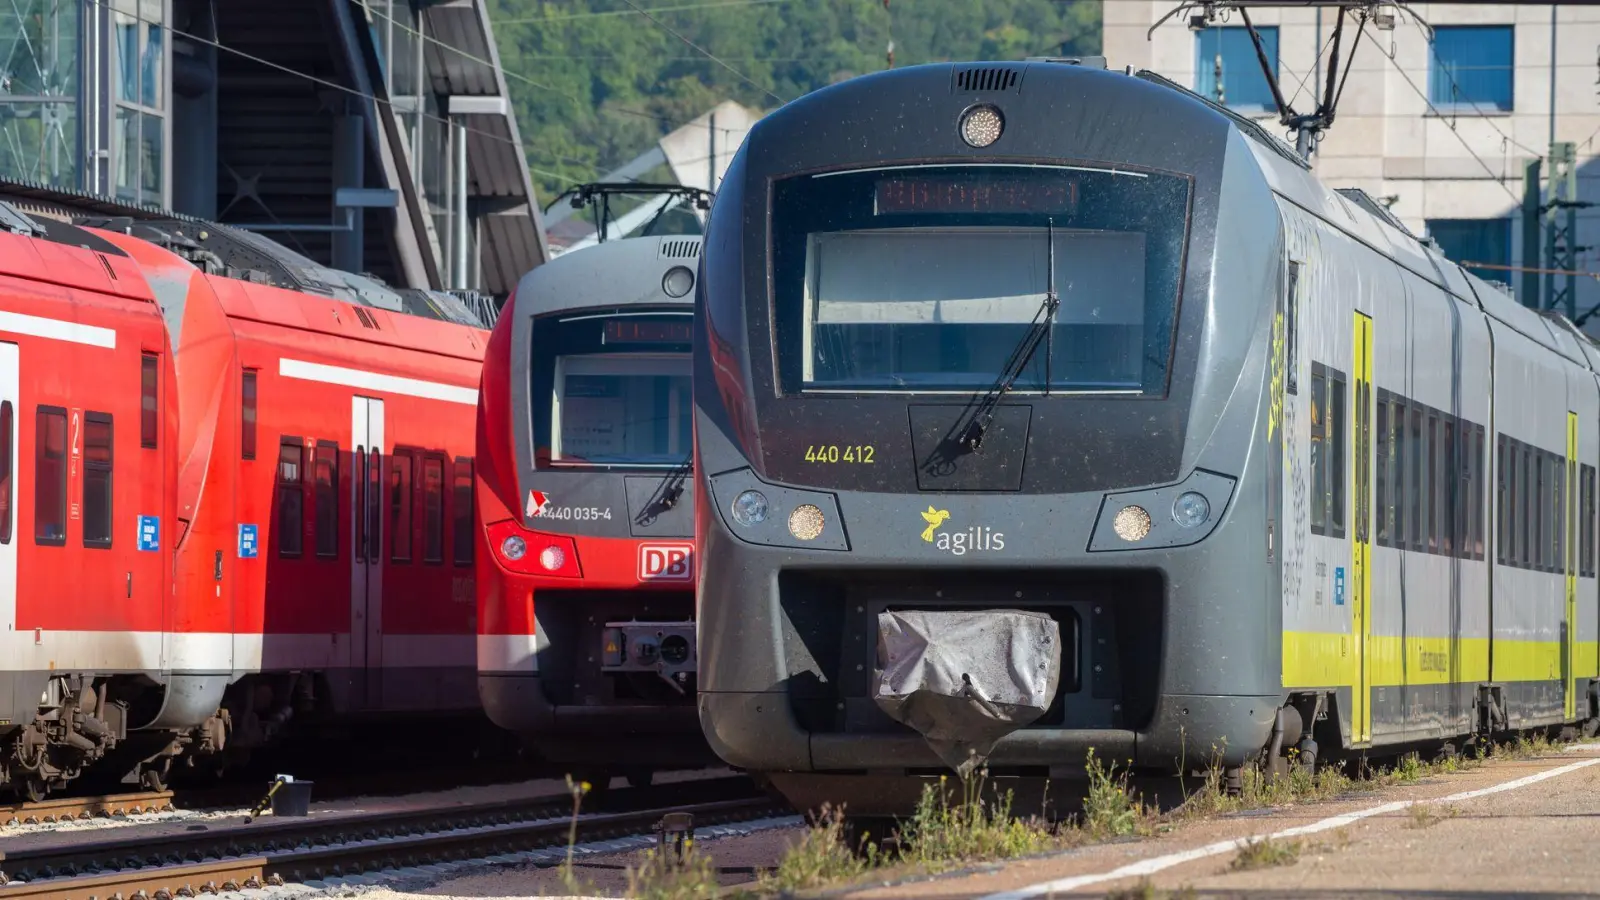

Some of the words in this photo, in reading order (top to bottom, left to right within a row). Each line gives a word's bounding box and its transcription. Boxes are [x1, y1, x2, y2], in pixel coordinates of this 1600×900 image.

[72, 412, 80, 455] 2
[804, 445, 839, 463] 440
[843, 445, 875, 463] 412
[573, 507, 612, 520] 035-4
[936, 526, 1005, 556] agilis
[645, 549, 687, 576] DB
